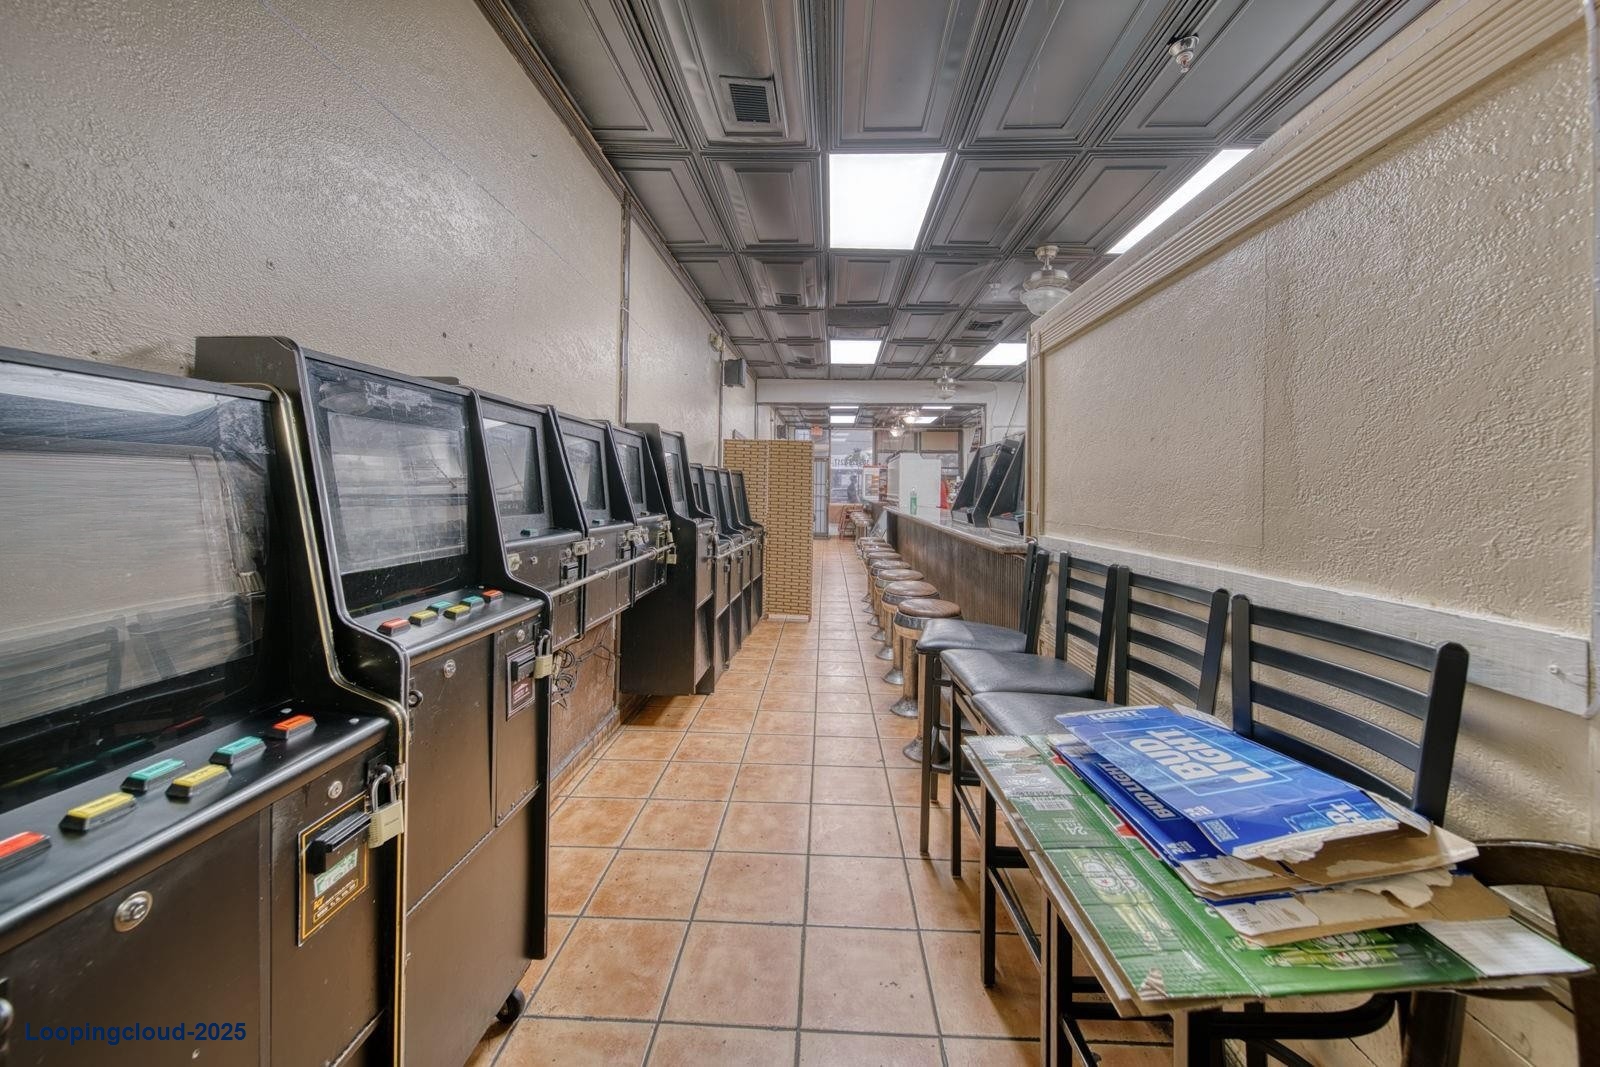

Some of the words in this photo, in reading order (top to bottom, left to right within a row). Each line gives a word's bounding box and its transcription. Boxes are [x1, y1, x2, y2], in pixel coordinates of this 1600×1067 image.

[1129, 738, 1219, 780] BUD
[1146, 729, 1273, 783] LIGHT
[1098, 762, 1145, 792] LIGHT
[1134, 791, 1177, 818] BUD
